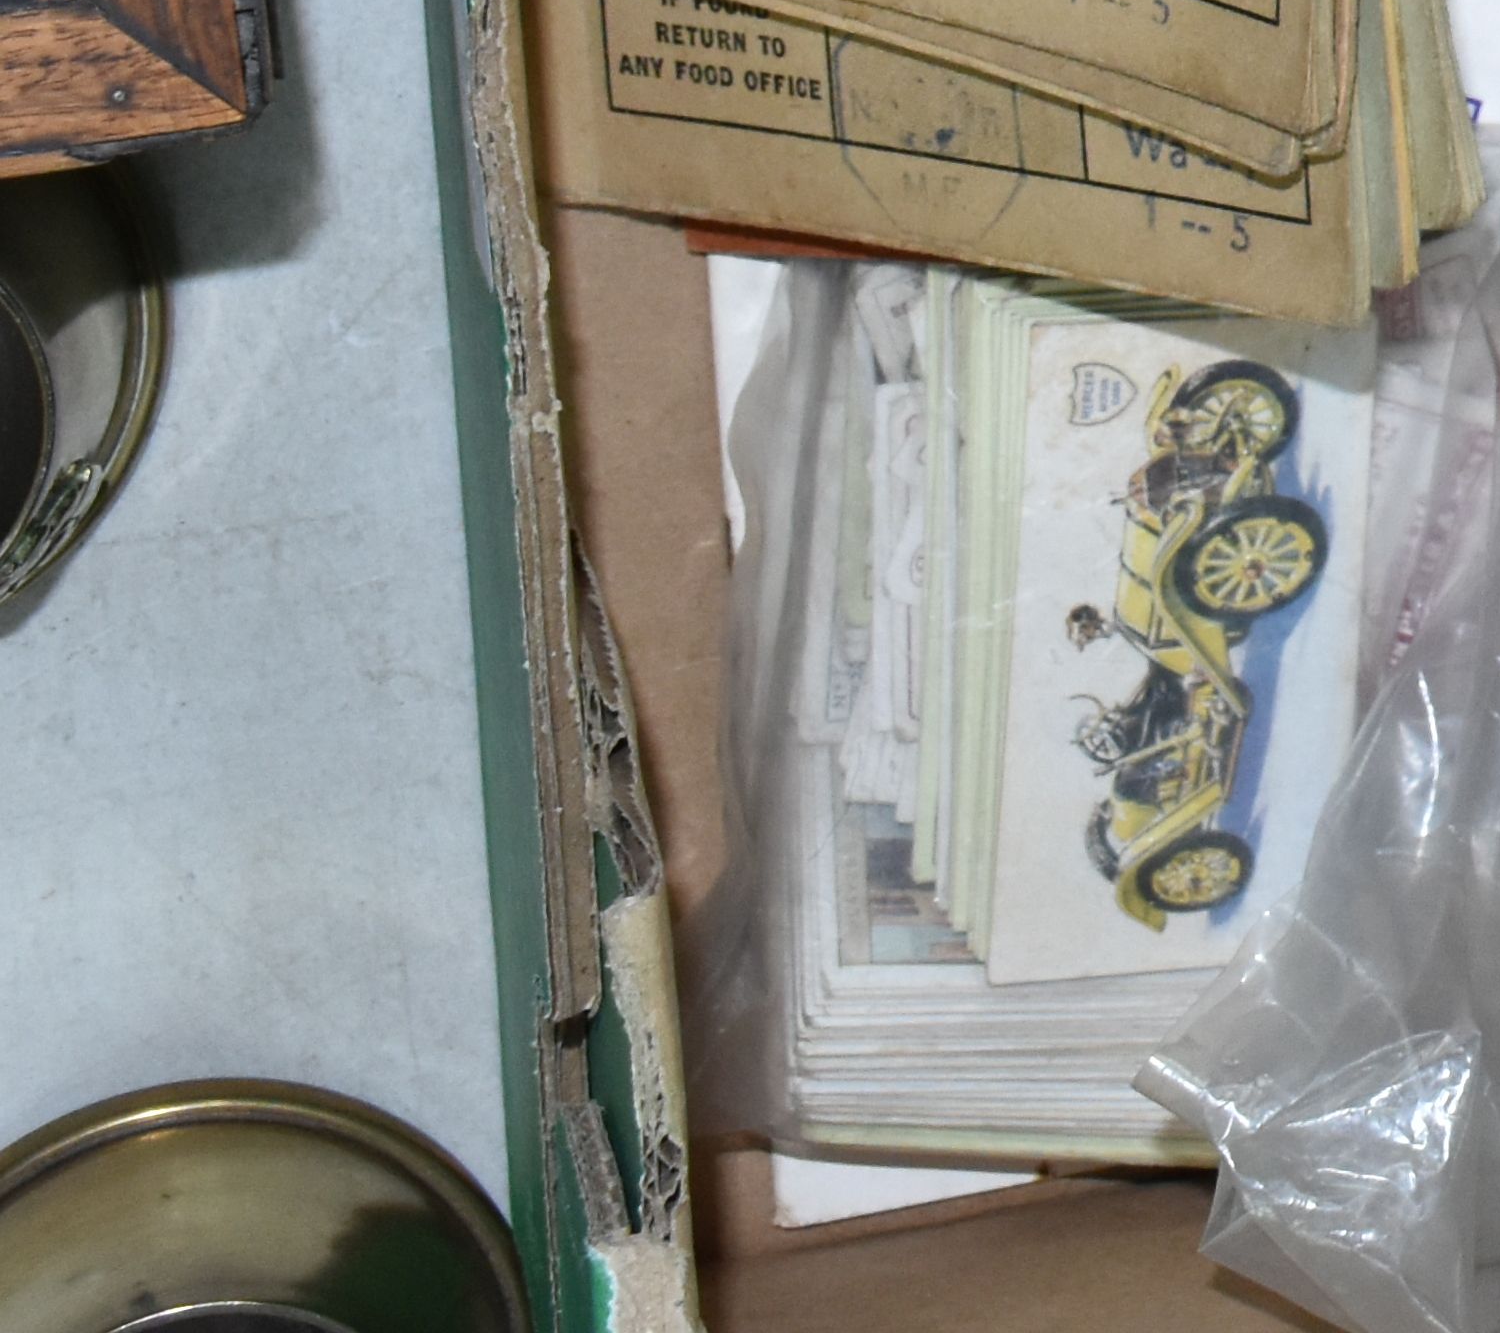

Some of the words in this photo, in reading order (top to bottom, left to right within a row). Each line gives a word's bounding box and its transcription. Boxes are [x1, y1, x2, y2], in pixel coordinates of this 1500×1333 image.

[655, 22, 748, 57] RETURN
[759, 32, 786, 59] TO
[620, 53, 665, 80] ANY
[675, 58, 734, 91] FOOD
[744, 70, 823, 101] OFFICE
[1229, 214, 1251, 251] 5
